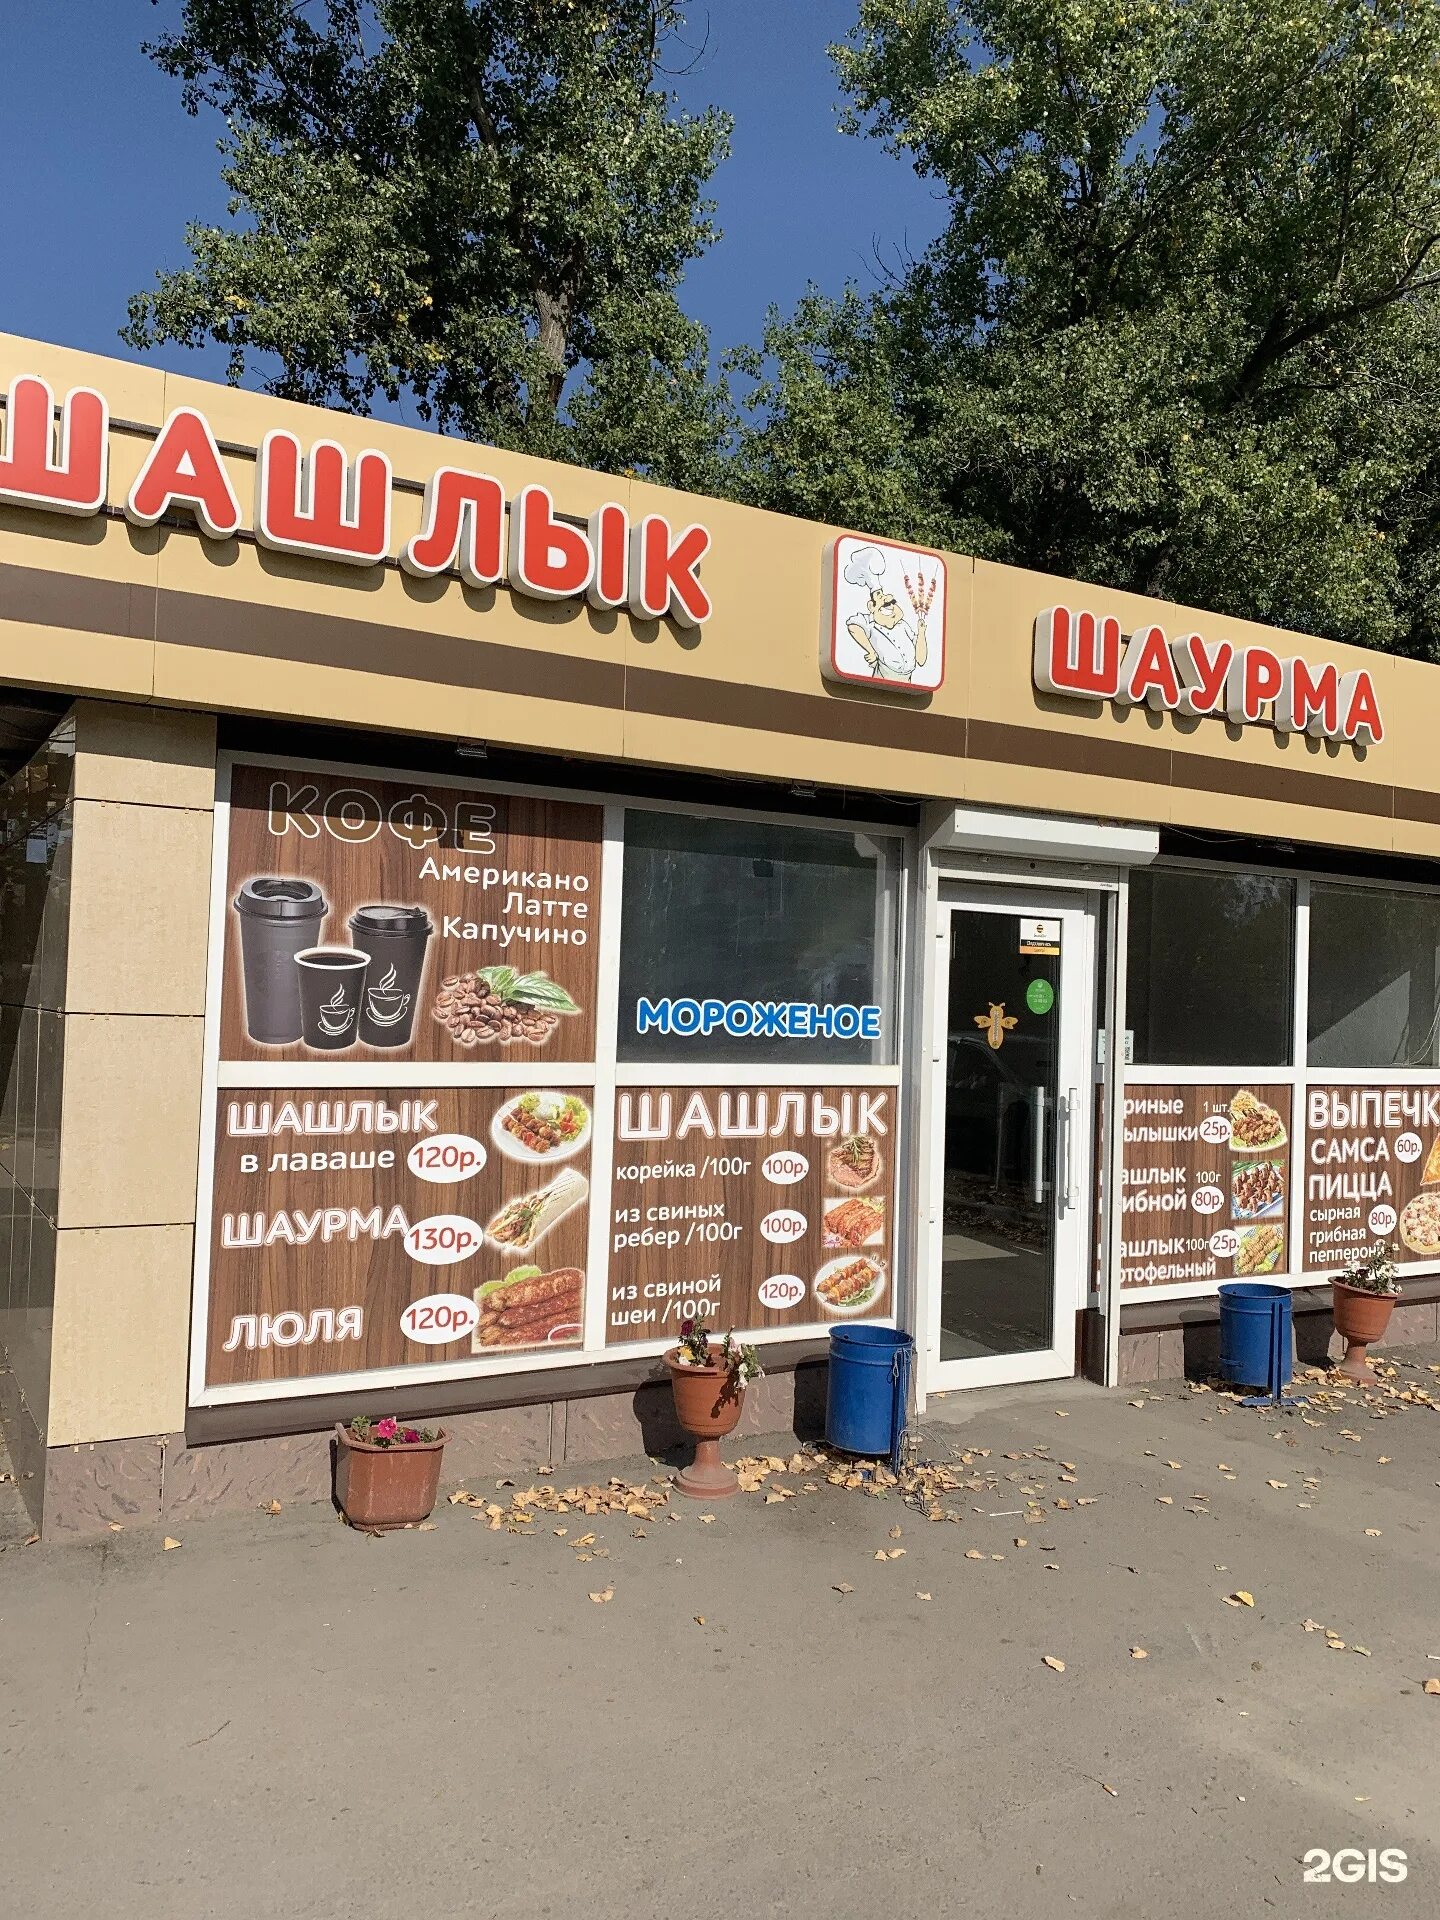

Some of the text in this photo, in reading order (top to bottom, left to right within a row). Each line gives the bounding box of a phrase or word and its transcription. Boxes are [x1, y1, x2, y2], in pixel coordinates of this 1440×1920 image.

[0, 373, 712, 626] ШАШЛЫК
[1047, 604, 1384, 746] ШАУРМА
[268, 781, 496, 855] КОФЕ
[419, 857, 590, 892] Американо
[502, 891, 588, 919] Латте
[443, 915, 587, 947] Капучино
[637, 997, 881, 1039] МОРОЖЕНОЕ
[227, 1100, 438, 1137] ШАШЛЫК
[618, 1092, 888, 1140] ШАШЛЫК
[1102, 1098, 1184, 1119] риные
[1203, 1102, 1209, 1113] 1
[1101, 1126, 1198, 1142] ылышки
[1203, 1121, 1231, 1138] 25р.
[413, 1146, 482, 1172] 120р.
[1310, 1136, 1390, 1165] САМСА
[1397, 1139, 1421, 1155] 60р.
[240, 1150, 395, 1173] в лаваше
[616, 1156, 752, 1183] корейка /100г
[765, 1159, 807, 1178] 100р.
[1098, 1167, 1221, 1187] ашлык 100г
[1308, 1170, 1393, 1204] ПИЦЦА
[615, 1203, 725, 1223] из свиных
[1098, 1188, 1187, 1214] ибной
[1194, 1191, 1224, 1209] 80р.
[221, 1205, 410, 1248] ШАУРМА
[763, 1217, 806, 1236] 100р.
[1309, 1206, 1361, 1224] сырная
[1371, 1211, 1395, 1228] 80р.
[409, 1226, 479, 1253] 130р.
[614, 1222, 743, 1252] ребер /100г
[1097, 1238, 1210, 1260] ашлык 100г
[1212, 1234, 1240, 1251] 25р.
[1309, 1226, 1366, 1247] грибная
[612, 1274, 722, 1301] из свиной
[761, 1283, 803, 1301] 120р.
[406, 1305, 475, 1334] 120р.
[611, 1298, 721, 1326] шеи /100г
[223, 1305, 363, 1352] ЛЮЛЯ
